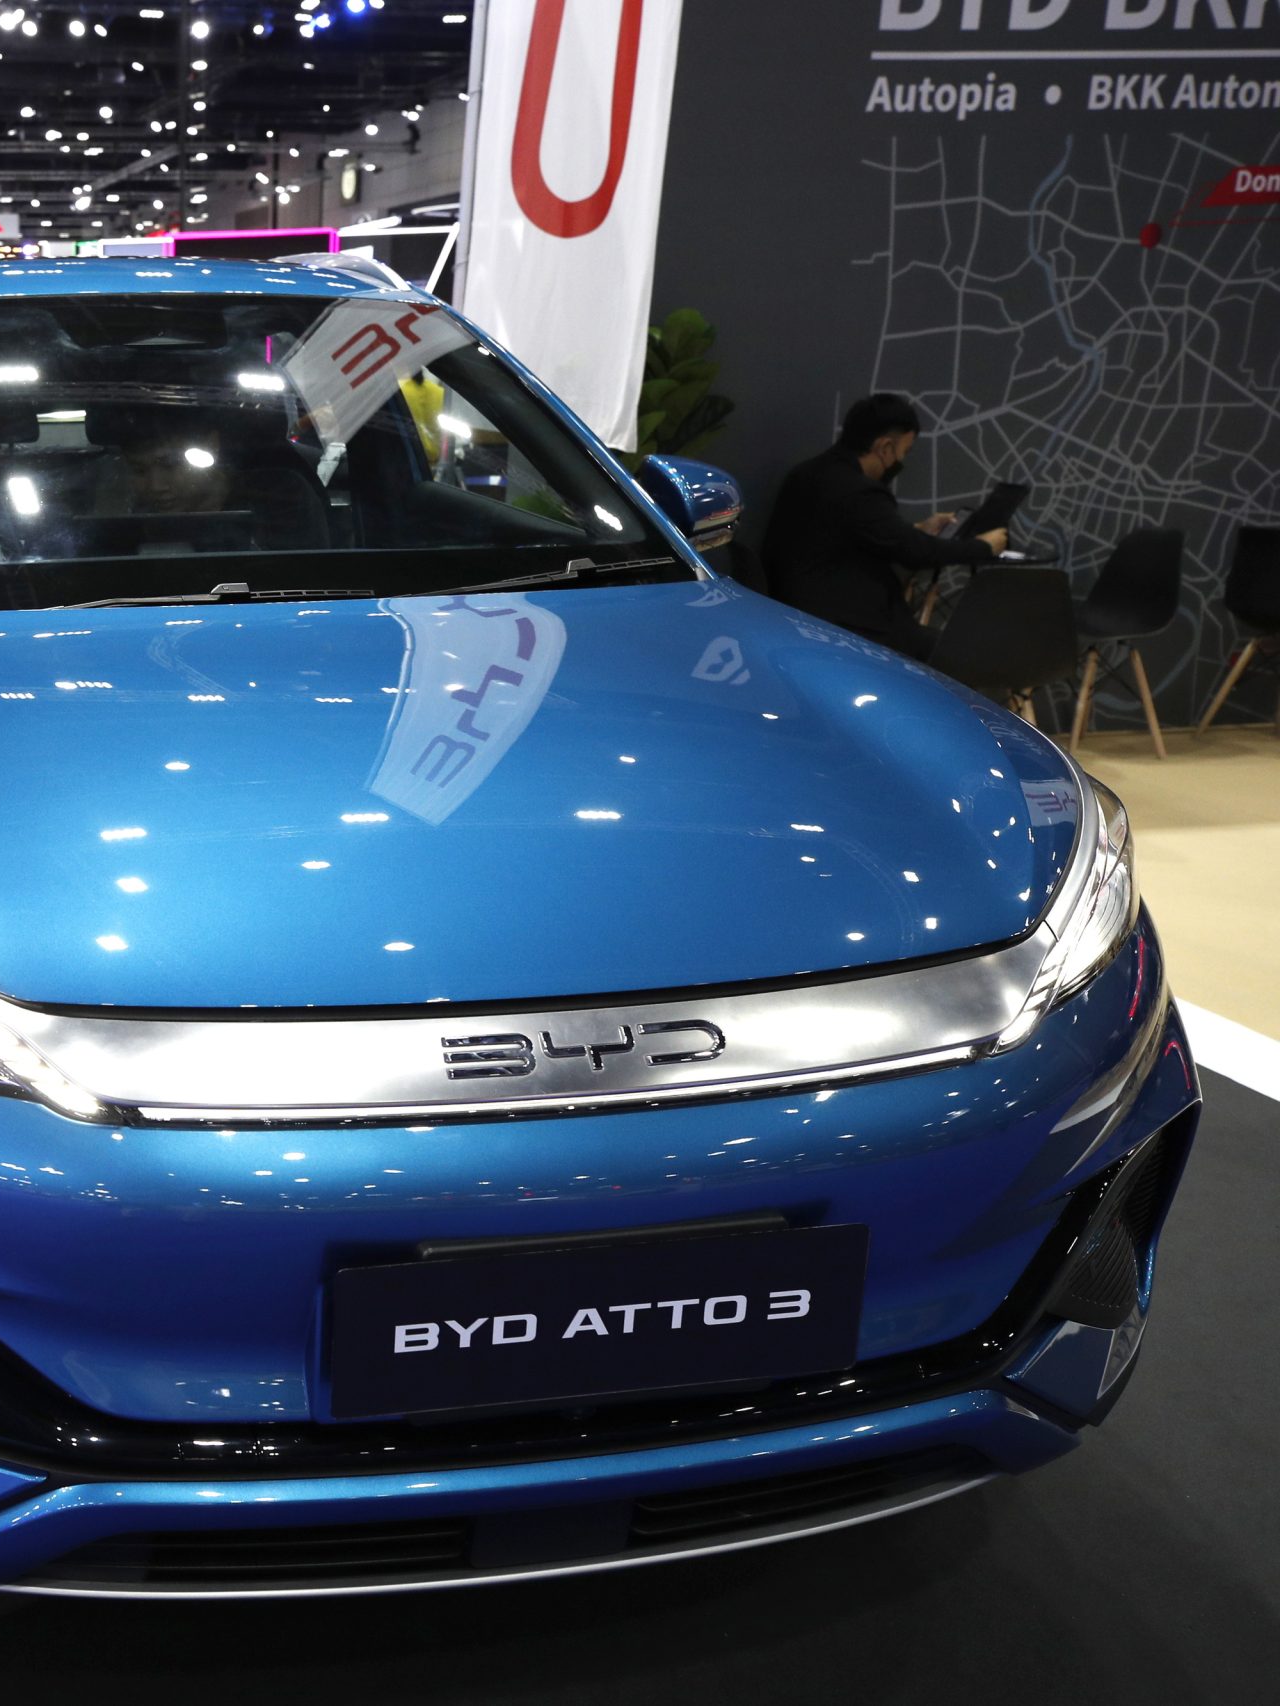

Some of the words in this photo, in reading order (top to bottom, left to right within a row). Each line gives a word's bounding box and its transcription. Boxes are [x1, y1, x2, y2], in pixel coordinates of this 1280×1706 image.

[866, 73, 1017, 121] Autopia
[1088, 73, 1168, 111] BKK
[441, 1019, 726, 1080] BYD
[393, 1313, 538, 1354] BYD
[562, 1294, 748, 1339] ATTO
[767, 1289, 812, 1321] 3
